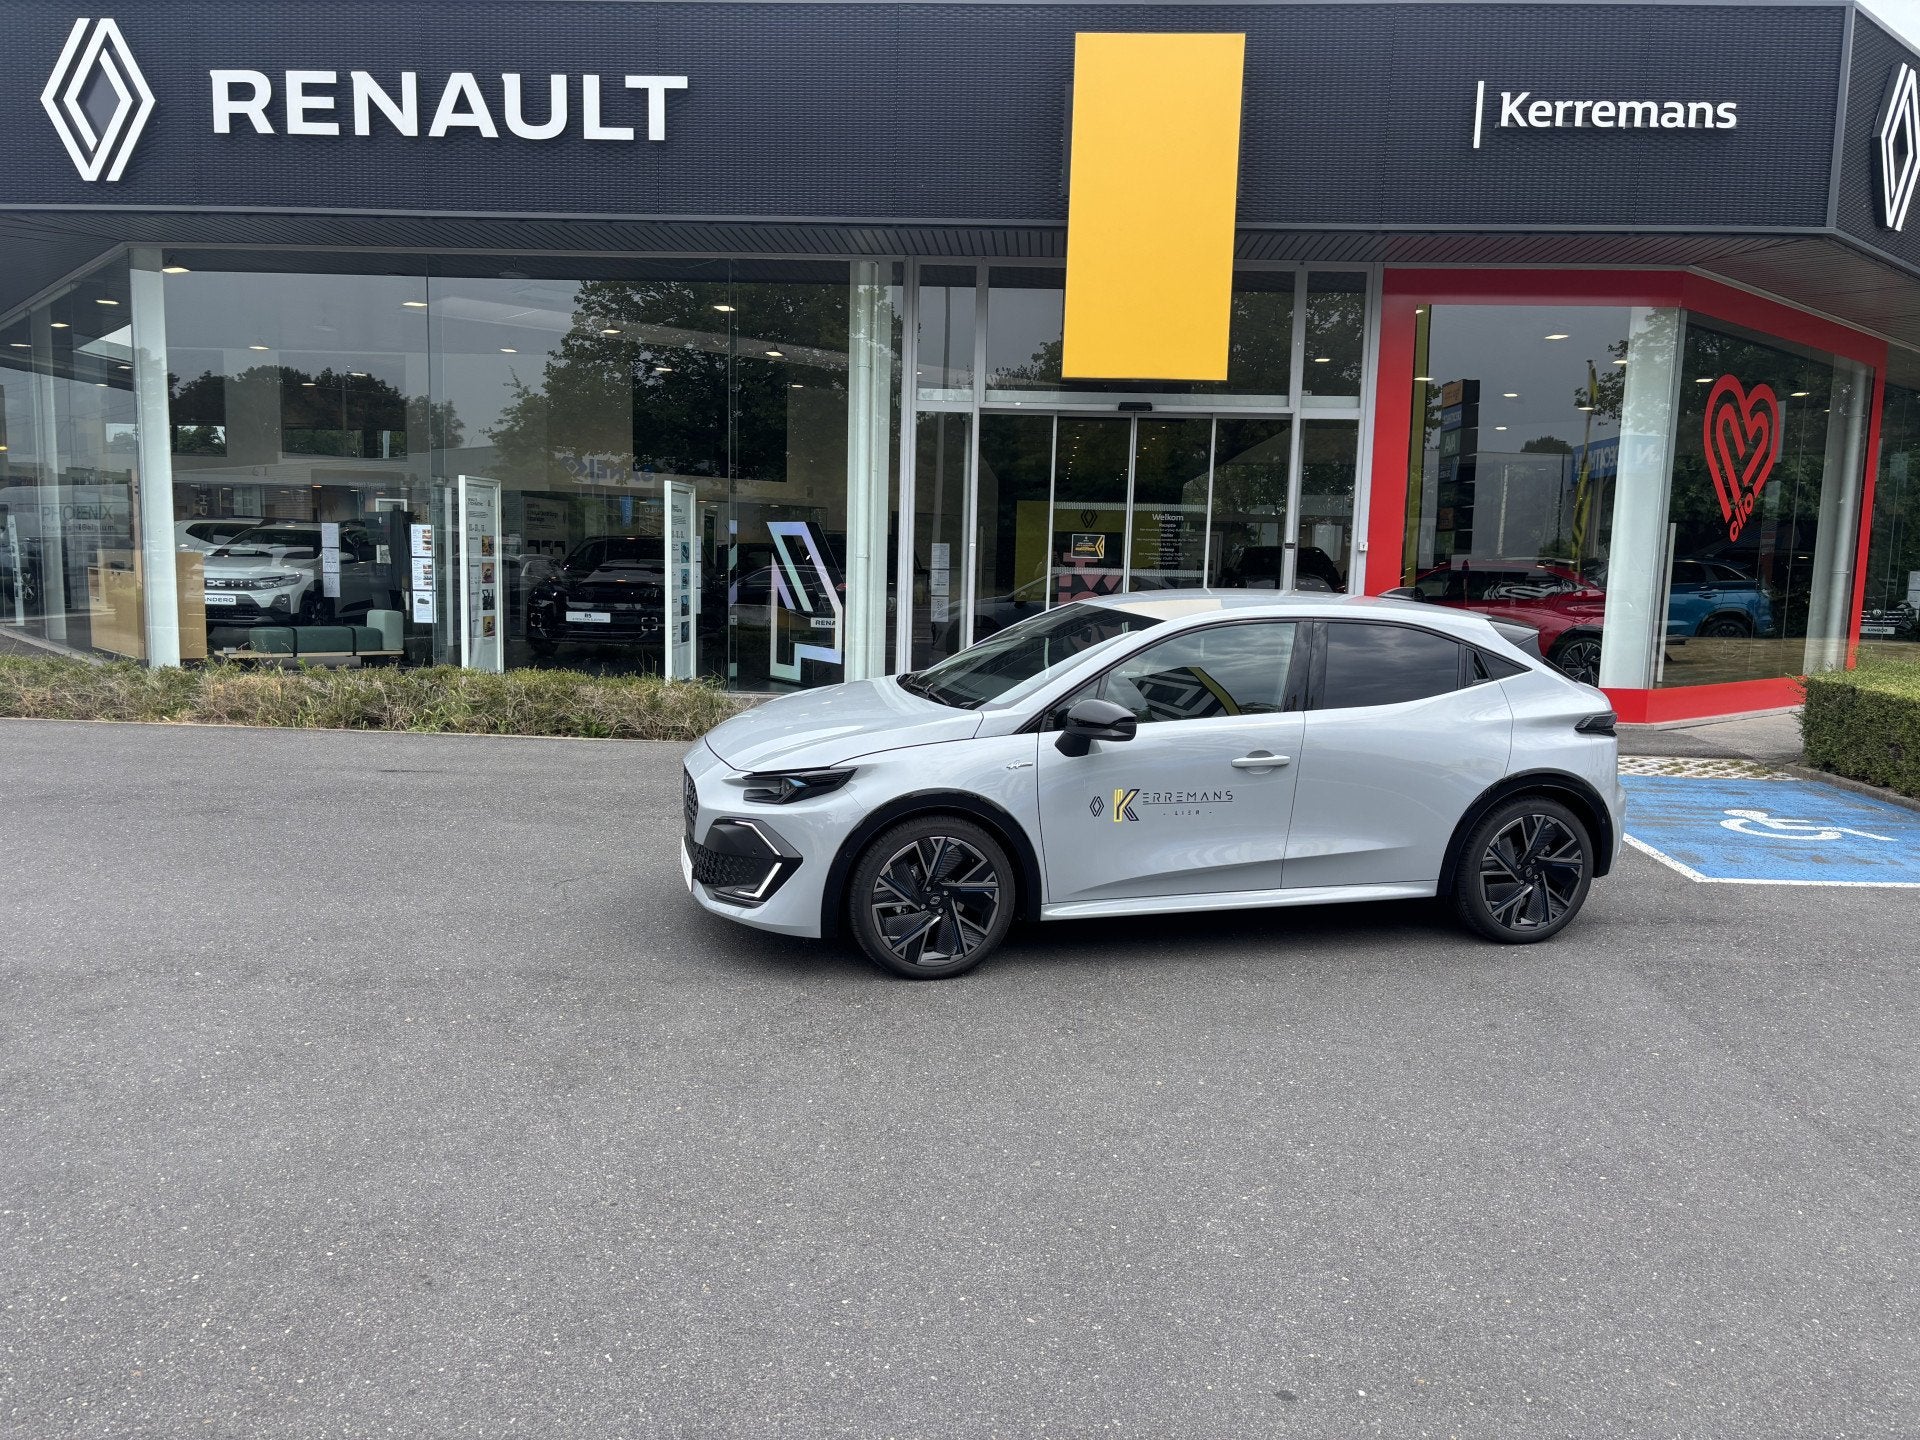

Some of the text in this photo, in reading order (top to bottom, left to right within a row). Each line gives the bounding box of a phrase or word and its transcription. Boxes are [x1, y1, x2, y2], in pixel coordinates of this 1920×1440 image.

[210, 70, 688, 141] RENAULT
[1500, 91, 1738, 129] Kerremans
[1152, 513, 1184, 521] Welkom
[1730, 493, 1754, 542] clio
